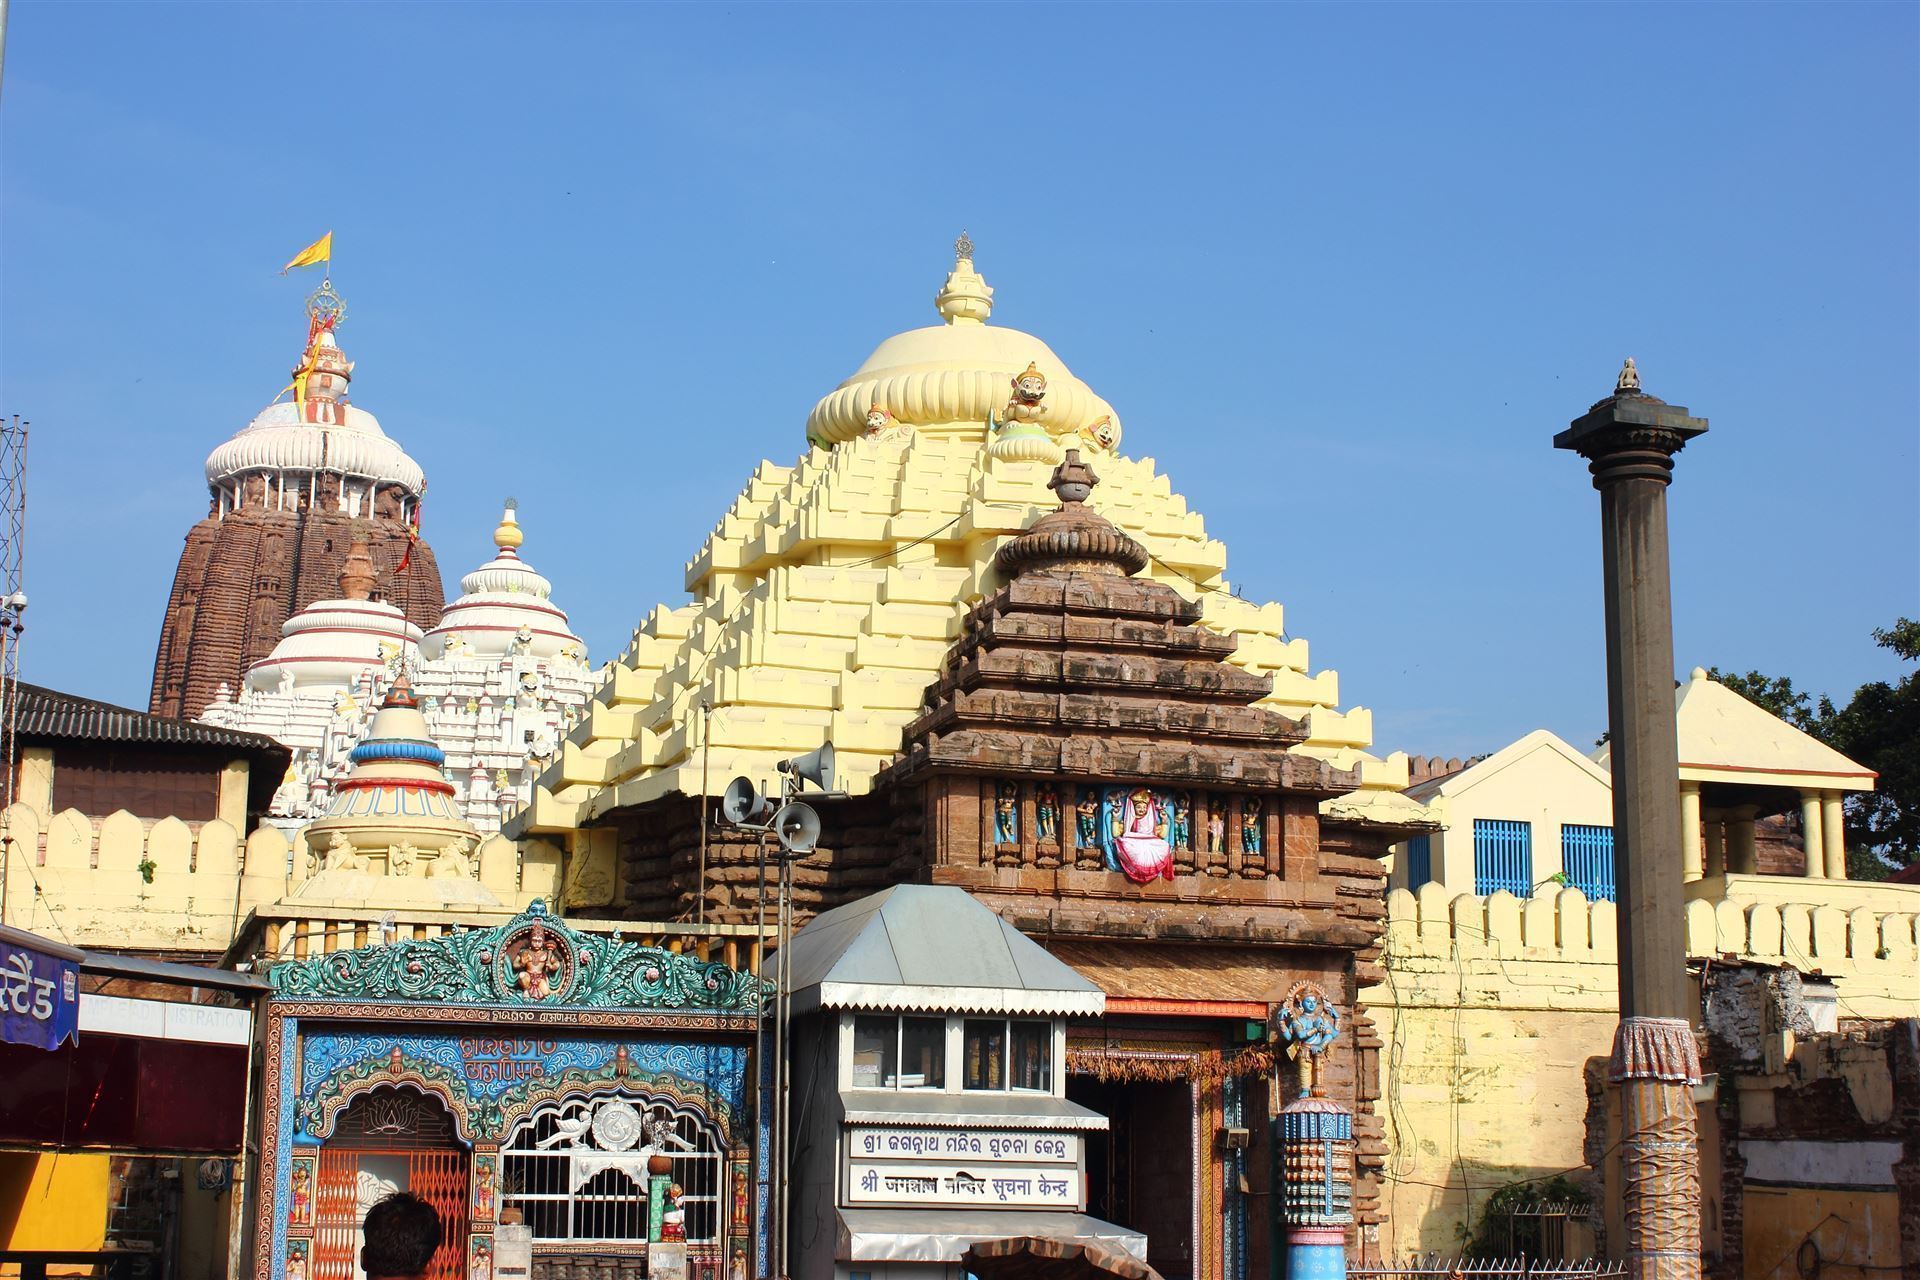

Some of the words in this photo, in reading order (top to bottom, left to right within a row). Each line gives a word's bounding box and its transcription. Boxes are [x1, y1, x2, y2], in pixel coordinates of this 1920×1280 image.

[863, 1134, 881, 1153] ଶ୍ରୀ
[888, 1135, 939, 1154] ଜଗନ୍ନାଥ
[946, 1132, 981, 1153] ମନ୍ଦିର
[989, 1138, 1028, 1158] ସୂଚନା
[1034, 1139, 1066, 1158] କେନ୍ଦ୍ର
[861, 1169, 879, 1192] श्री
[991, 1178, 1032, 1201] सूचना
[1037, 1173, 1069, 1197] केन्द्र
